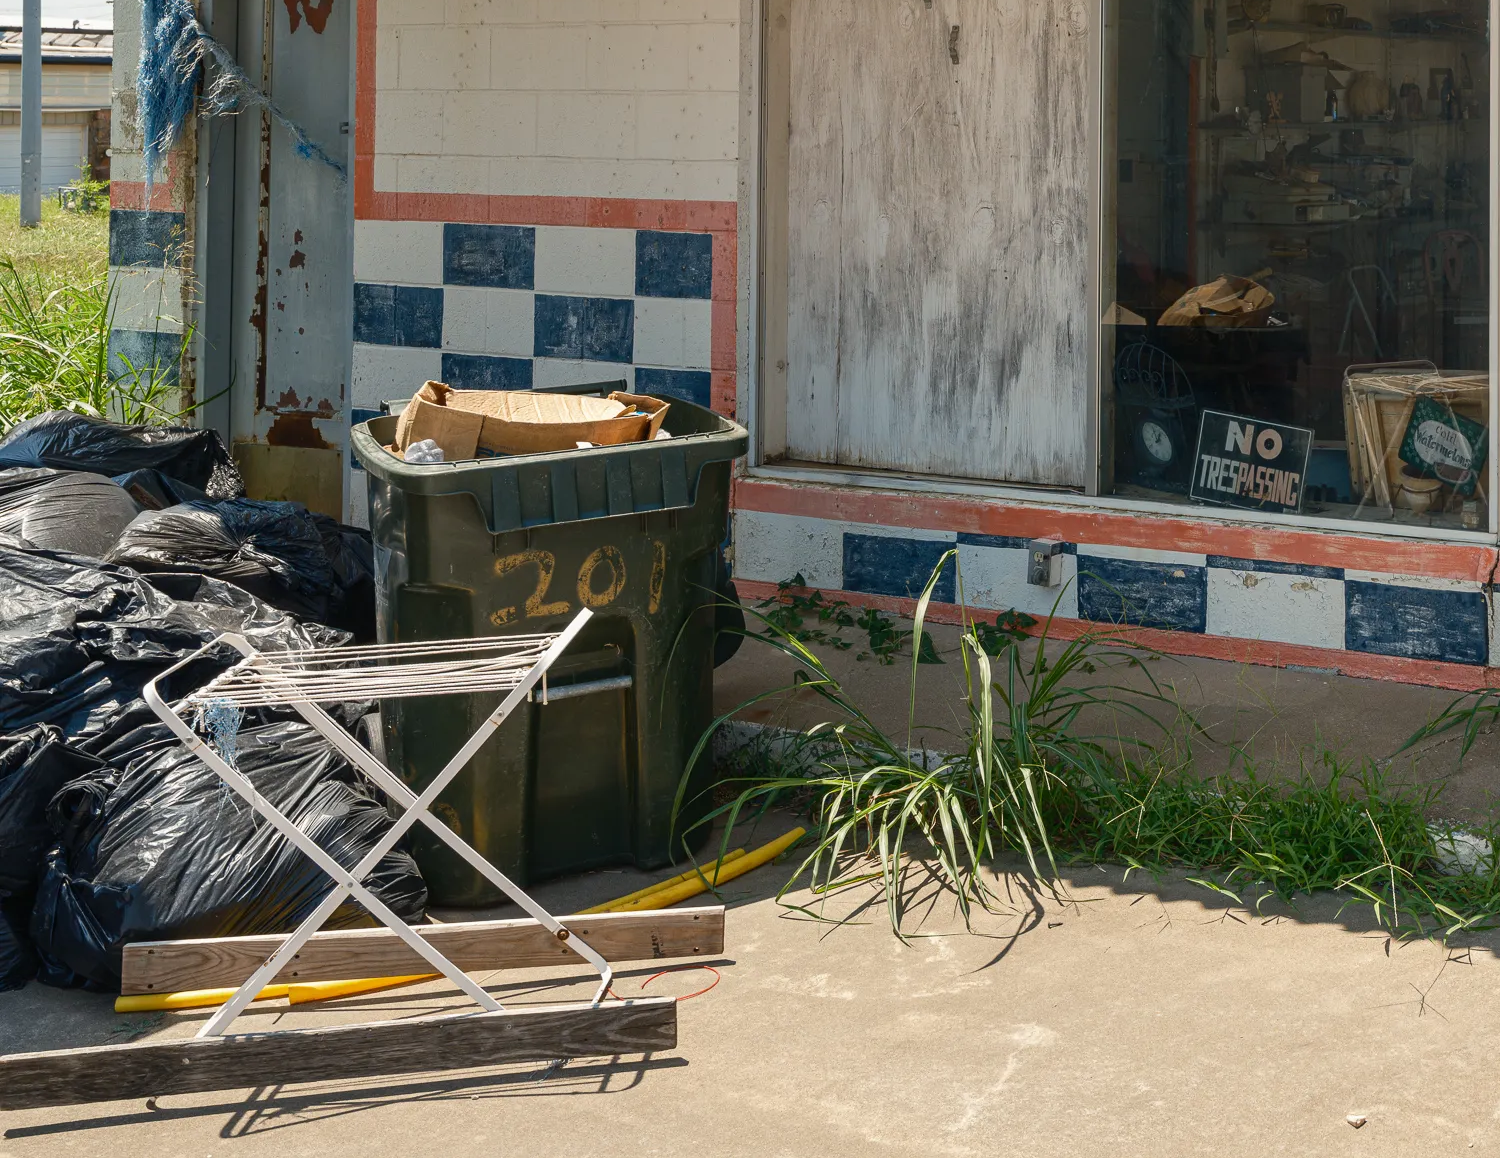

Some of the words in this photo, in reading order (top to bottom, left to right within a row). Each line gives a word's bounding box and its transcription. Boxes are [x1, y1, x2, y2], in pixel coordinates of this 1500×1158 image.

[1225, 420, 1282, 460] NO
[1199, 453, 1300, 507] TRESPASSING
[489, 540, 667, 627] 201
